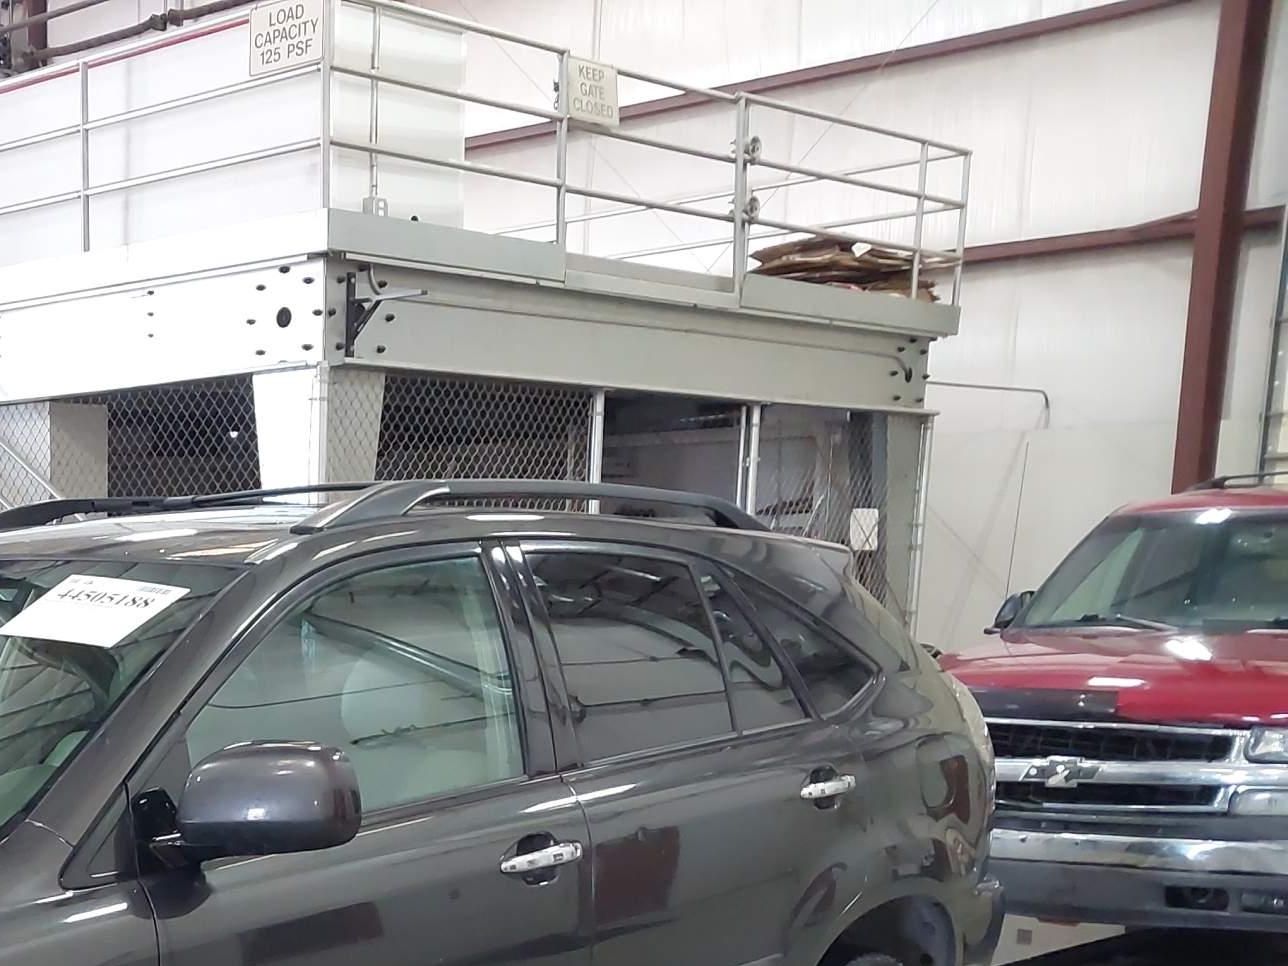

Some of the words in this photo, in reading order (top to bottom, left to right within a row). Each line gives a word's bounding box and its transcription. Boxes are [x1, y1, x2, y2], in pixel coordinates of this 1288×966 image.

[269, 4, 304, 27] LOAD
[254, 17, 319, 49] CAPACITY
[260, 47, 281, 65] 125
[287, 38, 313, 59] PSF
[578, 64, 605, 82] KEEP
[580, 82, 605, 101] GATE
[573, 97, 613, 119] CLOSED
